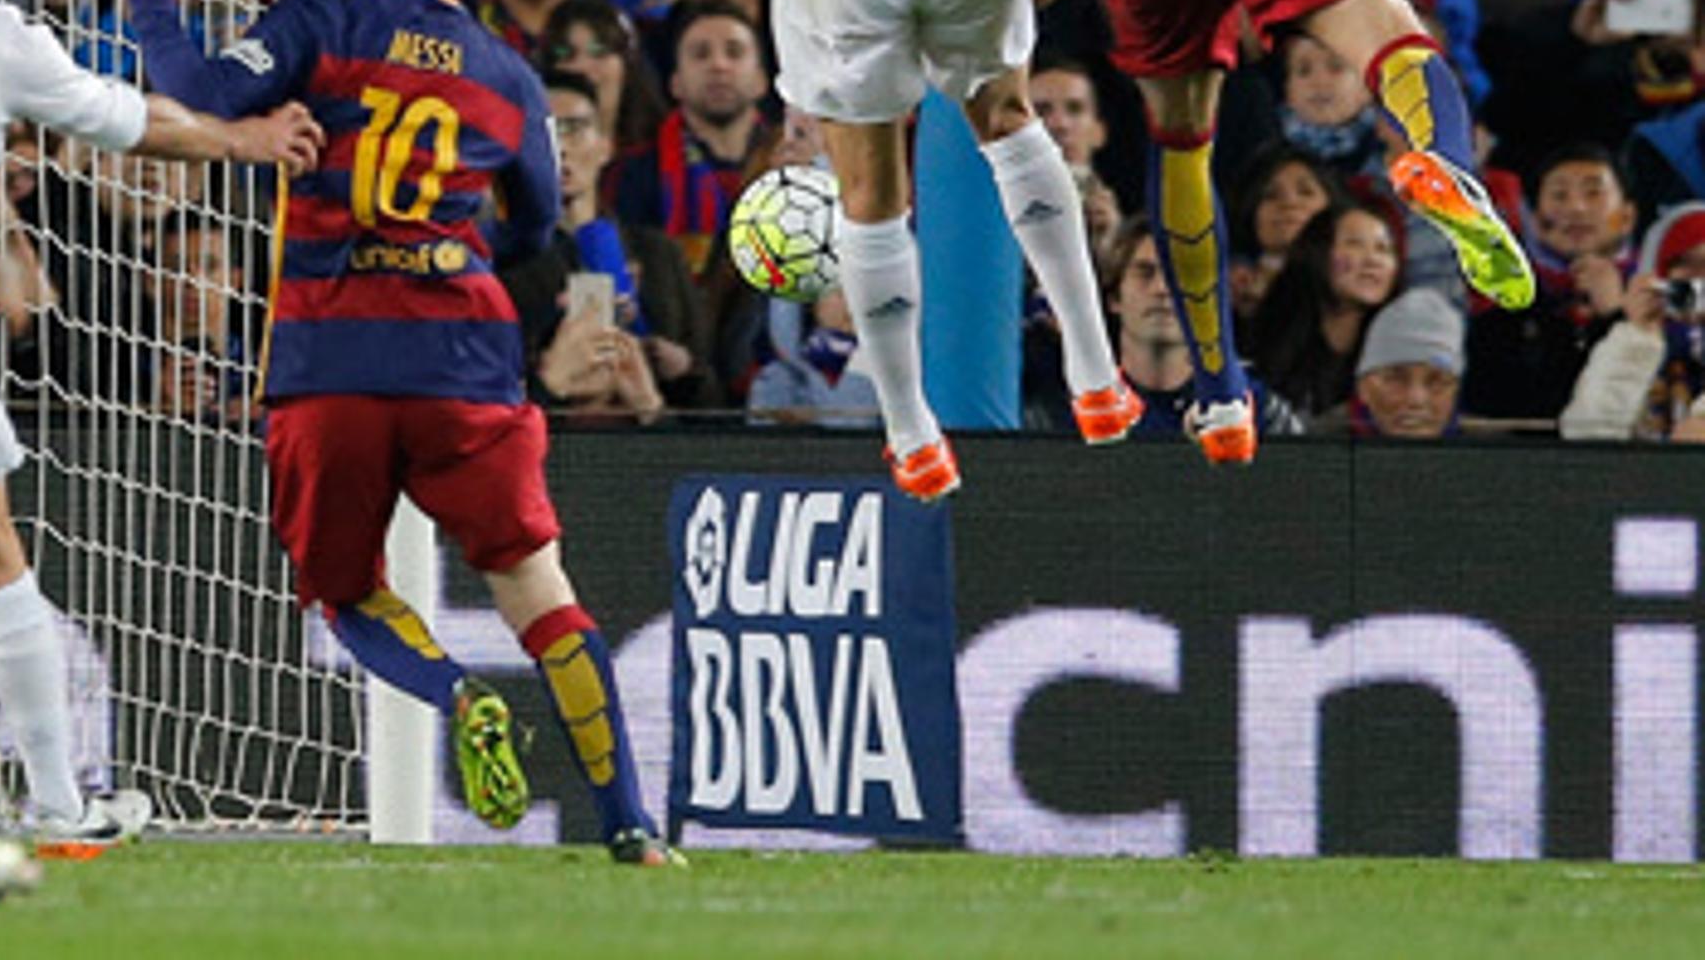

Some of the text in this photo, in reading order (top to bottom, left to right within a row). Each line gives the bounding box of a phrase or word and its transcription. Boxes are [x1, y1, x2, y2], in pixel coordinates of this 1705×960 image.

[386, 28, 463, 76] MESSI
[351, 87, 460, 227] 10
[728, 492, 883, 617] LIGA
[687, 628, 924, 820] BBVA
